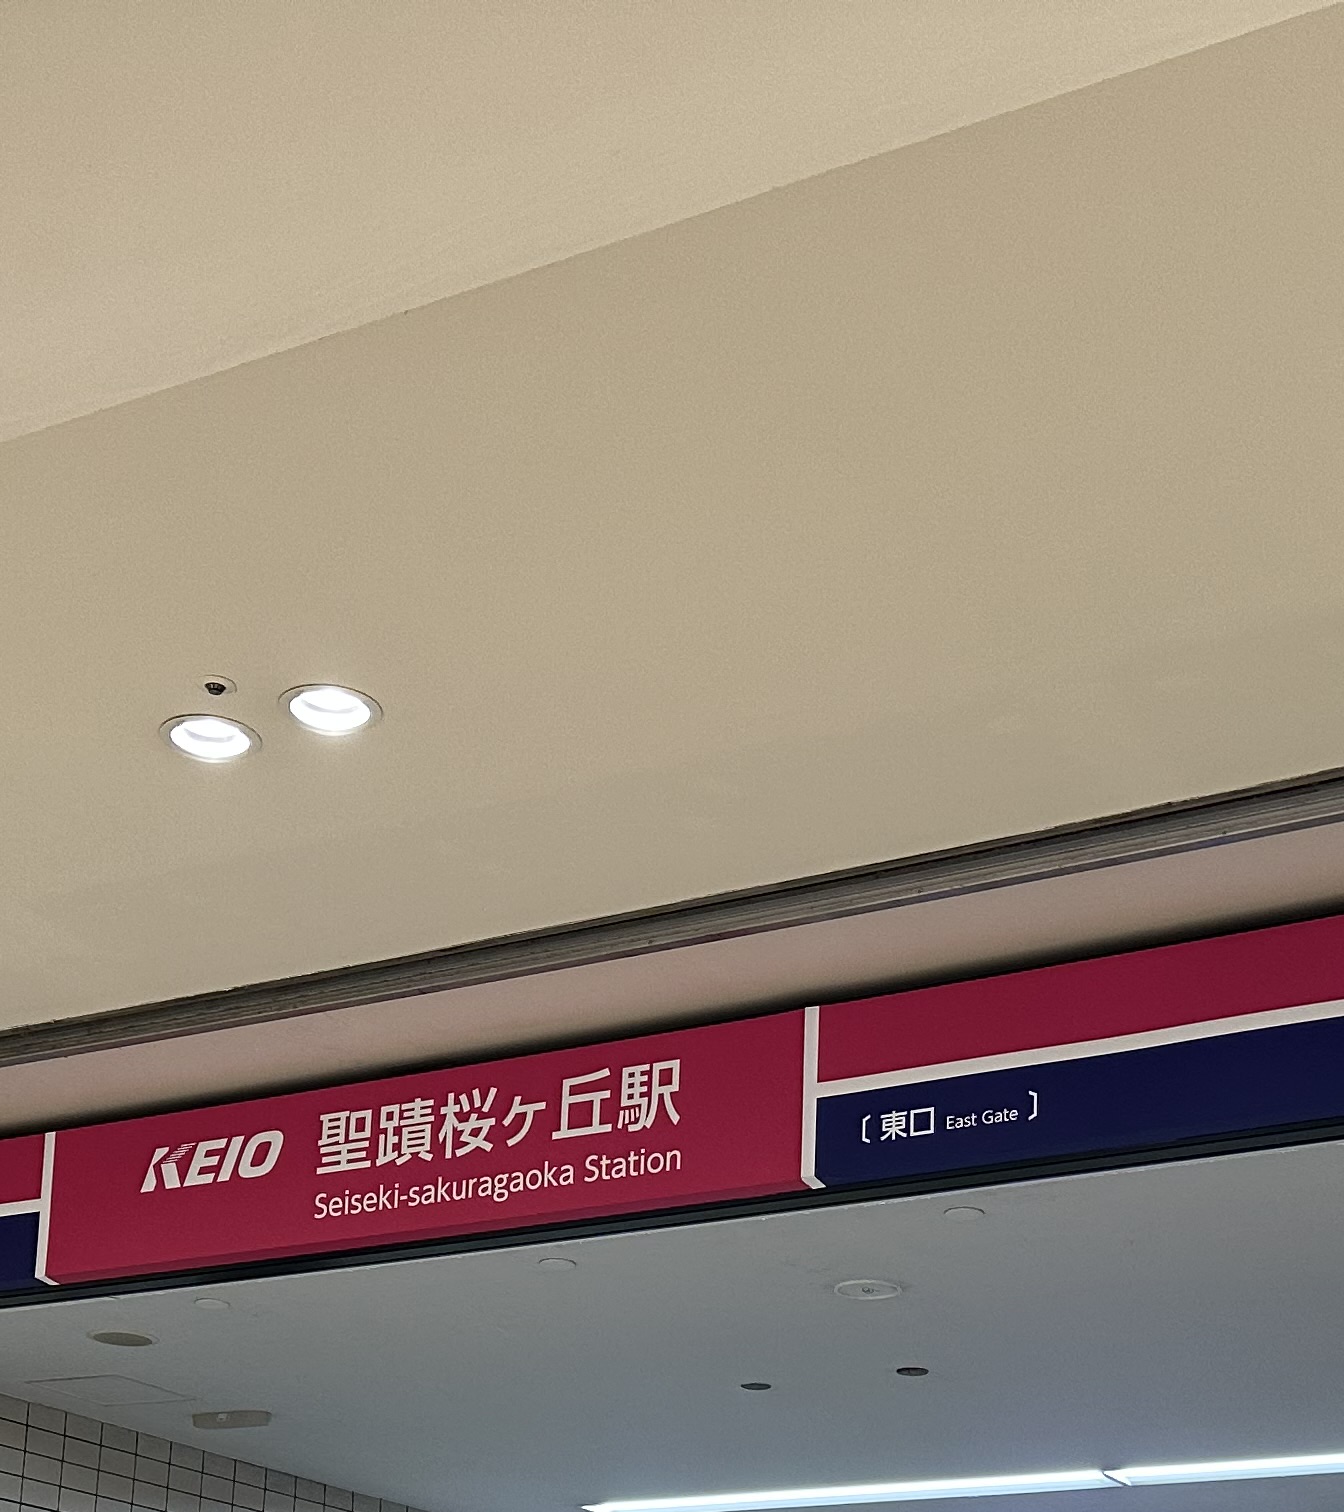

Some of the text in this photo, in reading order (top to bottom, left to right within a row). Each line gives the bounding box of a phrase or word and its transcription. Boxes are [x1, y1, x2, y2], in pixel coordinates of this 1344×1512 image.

[316, 1058, 681, 1177] 聖蹟桜ヶ丘駅
[946, 1113, 977, 1130] East
[981, 1108, 1019, 1124] Gate
[141, 1129, 283, 1193] KEIO
[313, 1145, 681, 1220] Seiseki-sakuragaoka Station
